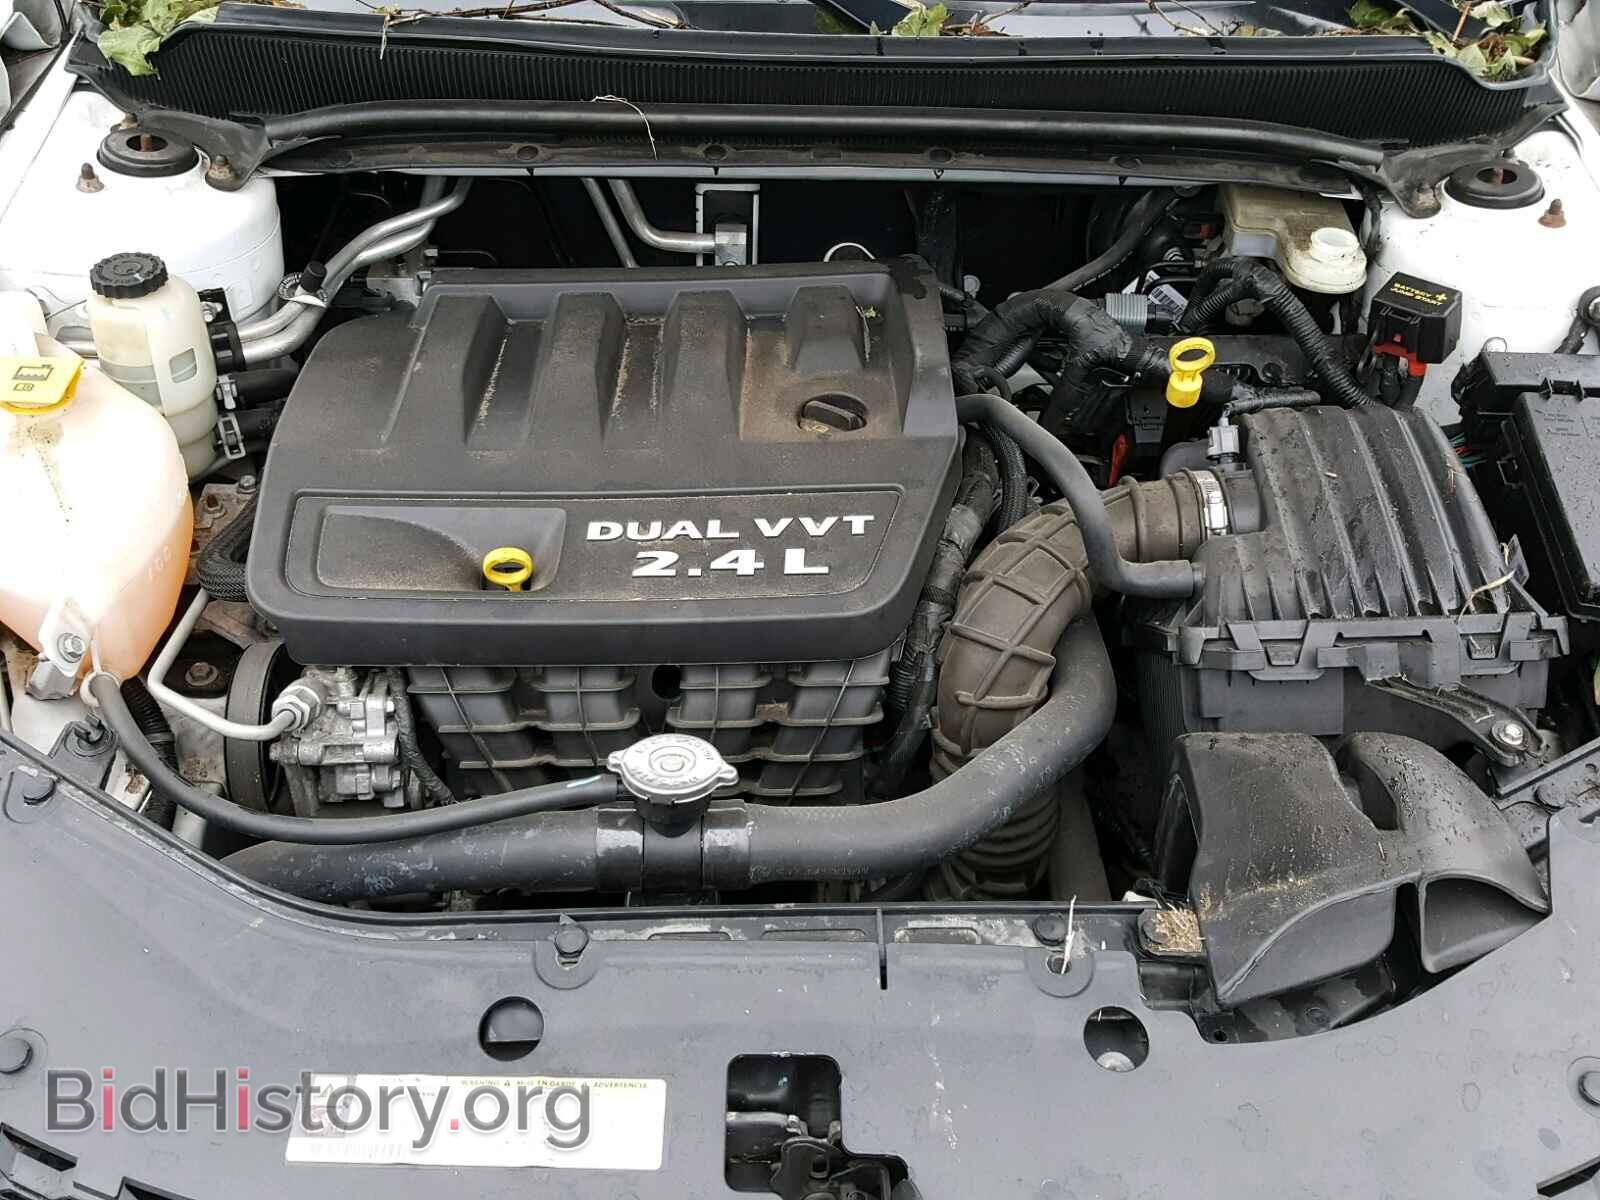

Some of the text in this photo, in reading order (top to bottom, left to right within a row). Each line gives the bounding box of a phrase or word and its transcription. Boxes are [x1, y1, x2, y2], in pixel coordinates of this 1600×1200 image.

[1393, 283, 1433, 297] BATTERY
[1414, 295, 1443, 306] START
[586, 515, 875, 541] DUAL VVT
[632, 547, 830, 577] 2.4 L
